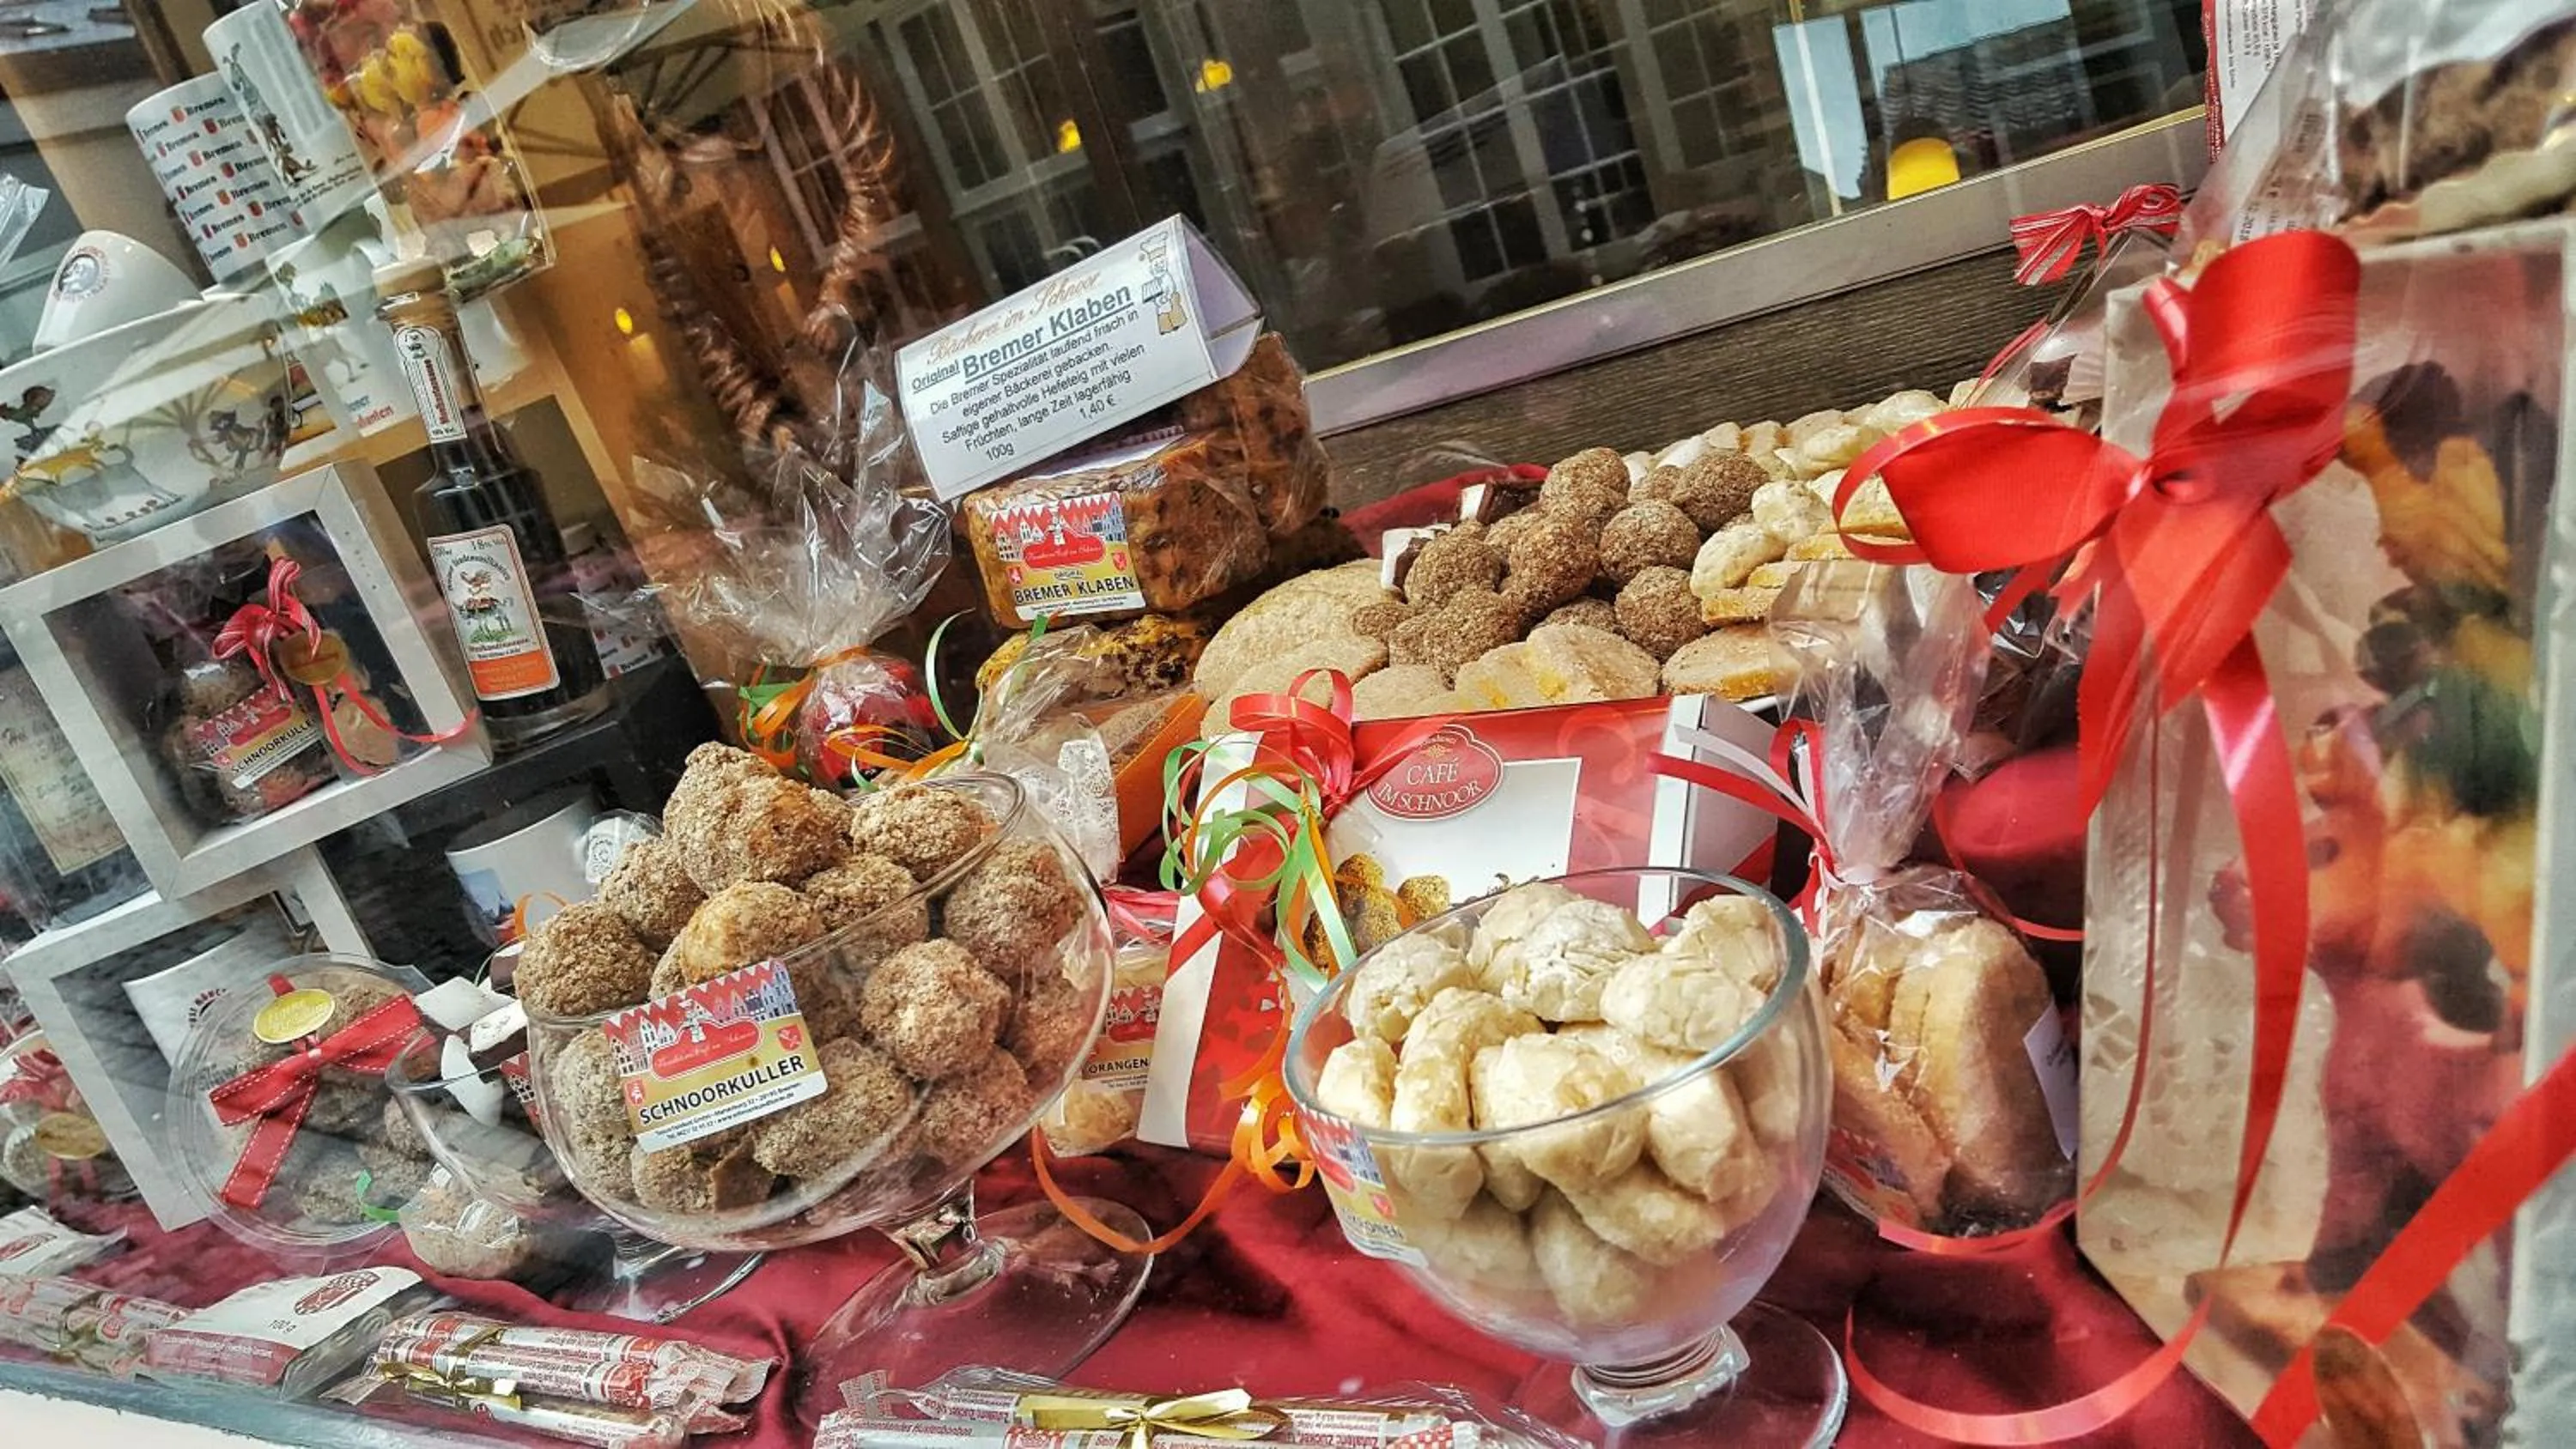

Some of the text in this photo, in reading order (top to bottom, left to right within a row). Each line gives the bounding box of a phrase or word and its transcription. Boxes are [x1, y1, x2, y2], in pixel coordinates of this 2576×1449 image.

[185, 96, 226, 115] Bremen
[911, 284, 1133, 391] Original Bremer Klaben
[930, 311, 1139, 415] Die Bremer Spezialität laufend frisch in
[941, 343, 1145, 445] Saftige gehaltvolle Hefeteig mit vielen
[962, 343, 1114, 419] eigener Bäckerei gebacken.
[964, 368, 1131, 453] Früchten, lange Zeit lagerfähig
[1079, 395, 1117, 421] 1,40 €
[985, 443, 1014, 463] 100g
[1014, 576, 1134, 603] BREMER KLABEN
[1406, 758, 1459, 785] CAFÉ
[1377, 780, 1483, 811] IM SCHNOOR
[1089, 1058, 1148, 1073] ORANGEN
[640, 1055, 805, 1125] SCHNOORKULLER
